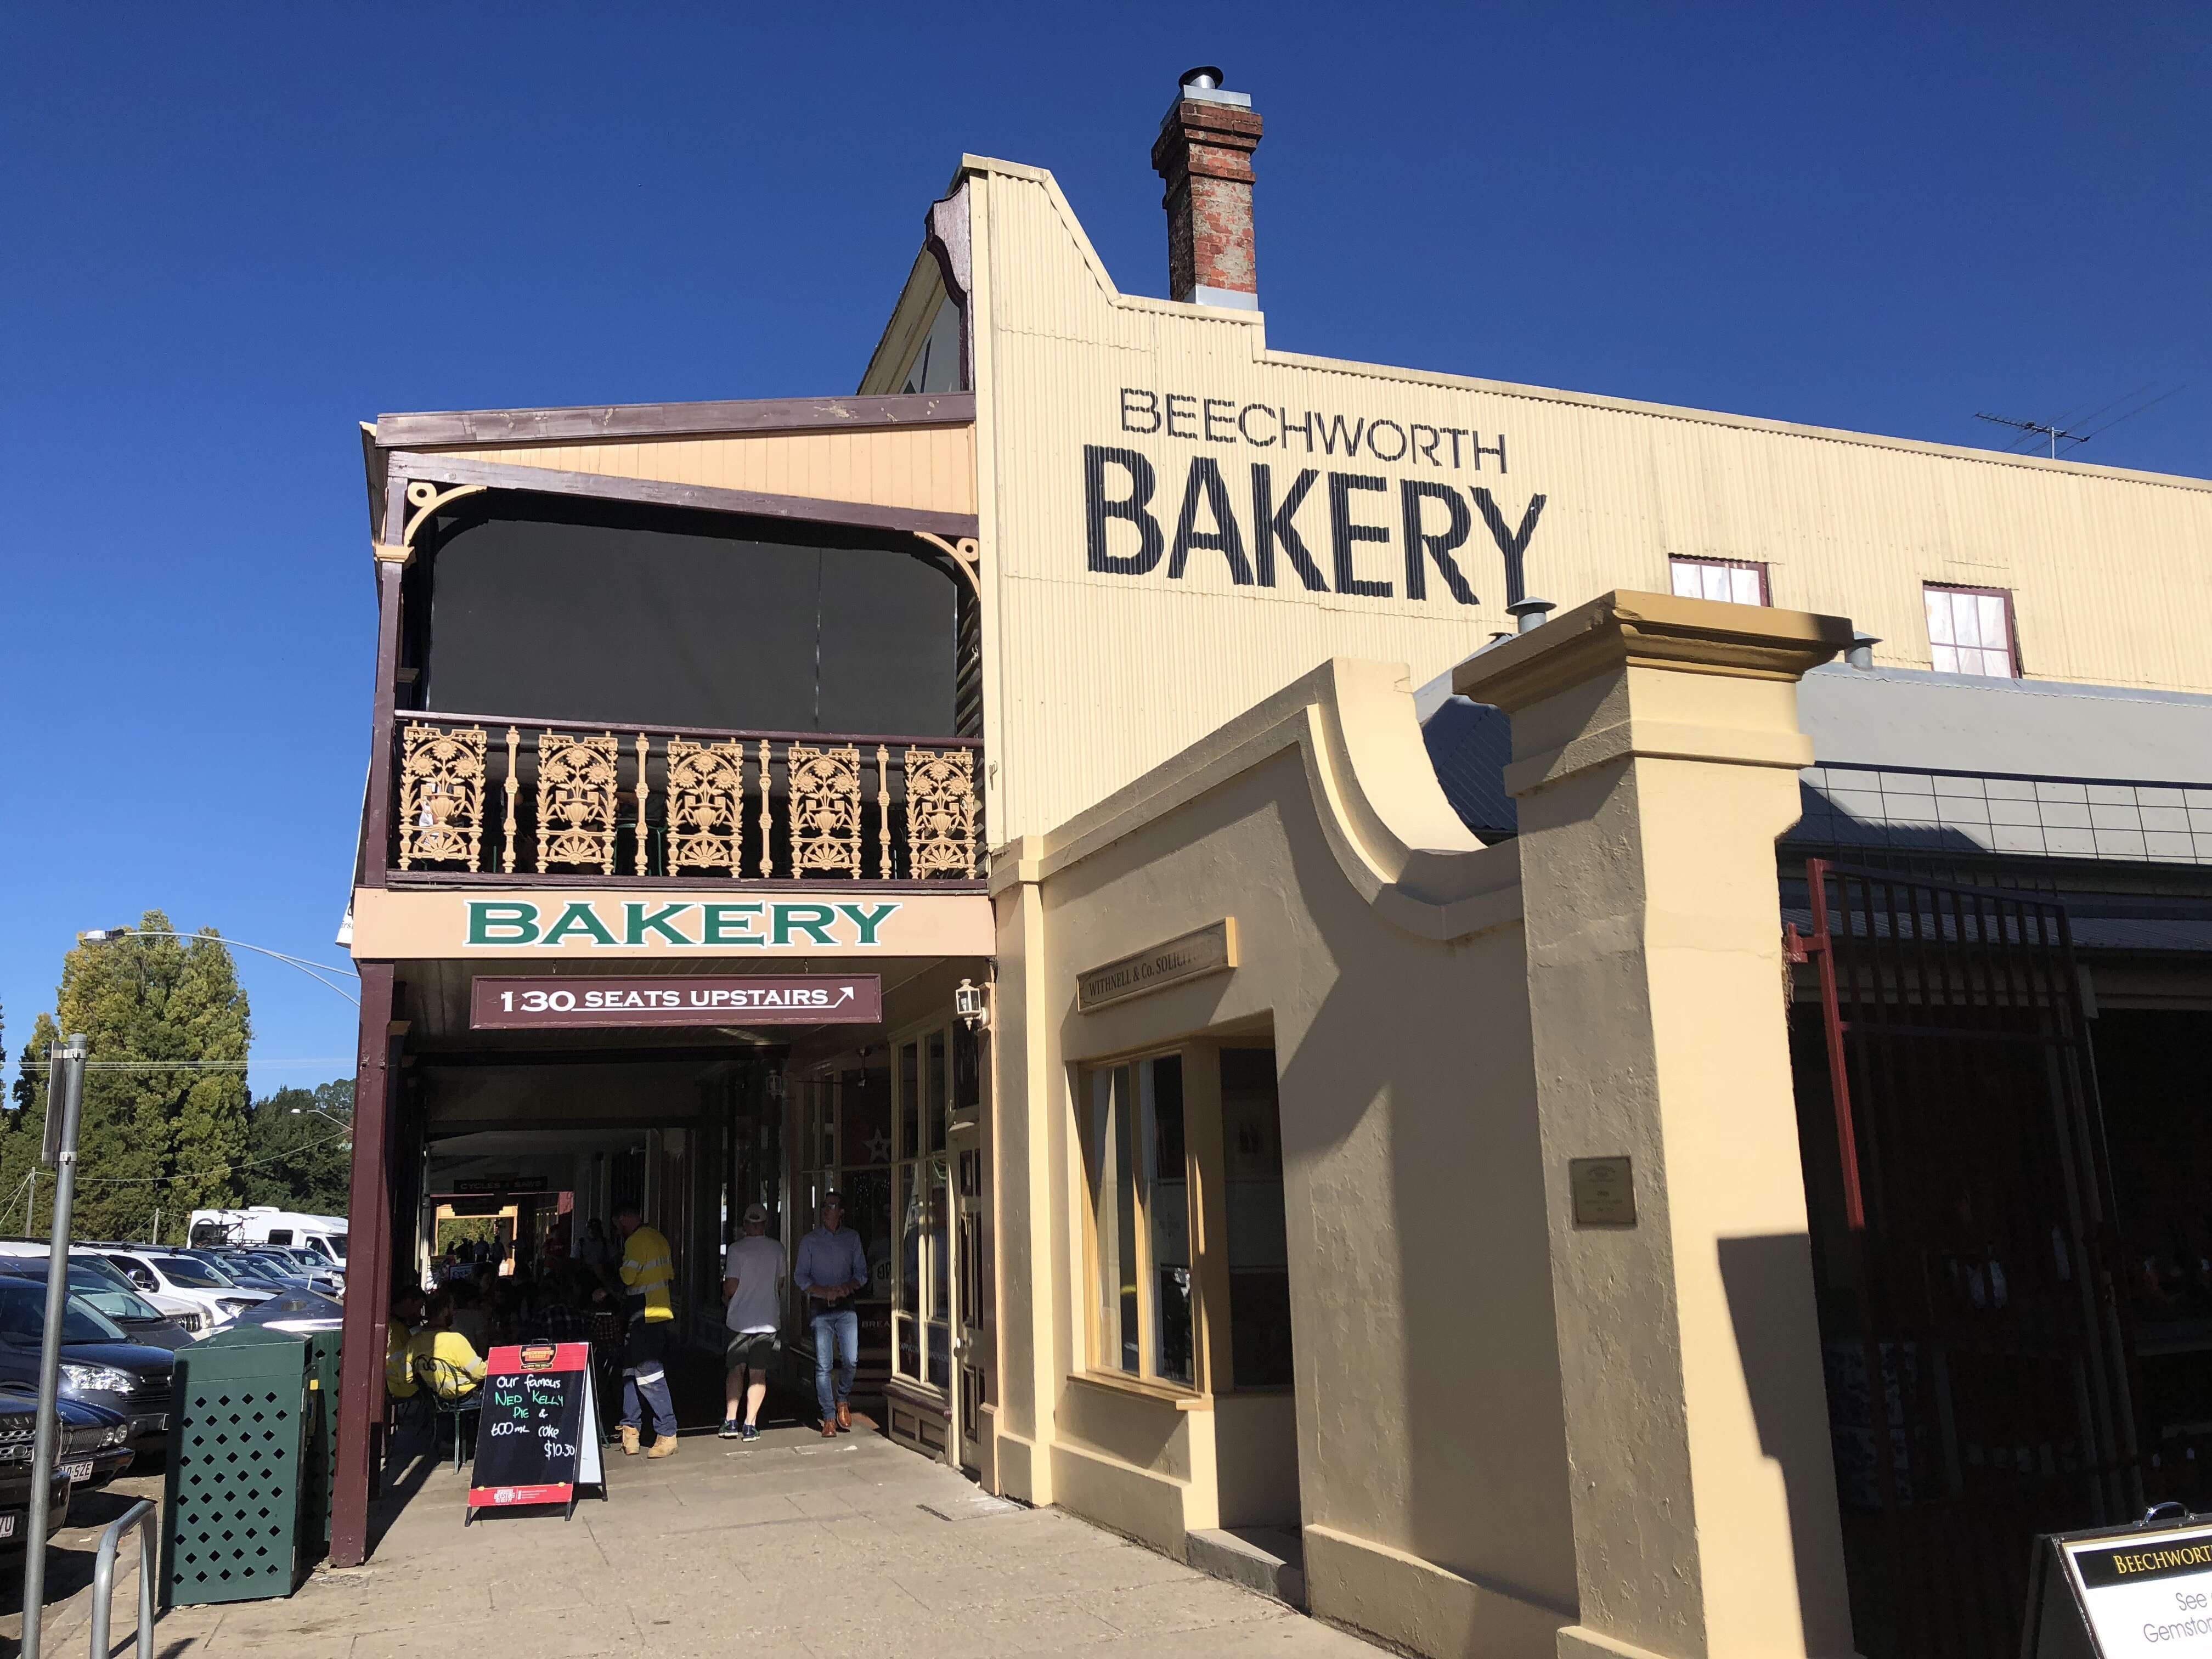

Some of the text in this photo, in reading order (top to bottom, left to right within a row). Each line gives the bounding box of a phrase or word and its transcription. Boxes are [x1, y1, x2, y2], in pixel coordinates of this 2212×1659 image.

[1120, 387, 1508, 475] BEECHWORTH
[1084, 443, 1547, 607] BAKERY
[462, 899, 904, 949] BAKERY
[1089, 969, 1131, 997] WITHNELL
[1133, 963, 1140, 983] &
[1141, 962, 1154, 979] Co.
[500, 988, 830, 1013] 130 SEATS UPSTAIRS
[496, 1374, 561, 1393] Our famous
[495, 1390, 563, 1407] NED KELLY
[512, 1406, 549, 1419] PIE &
[544, 1440, 575, 1460] $10.30
[2113, 1544, 2212, 1575] BEECHWORT
[2176, 1592, 2208, 1611] See
